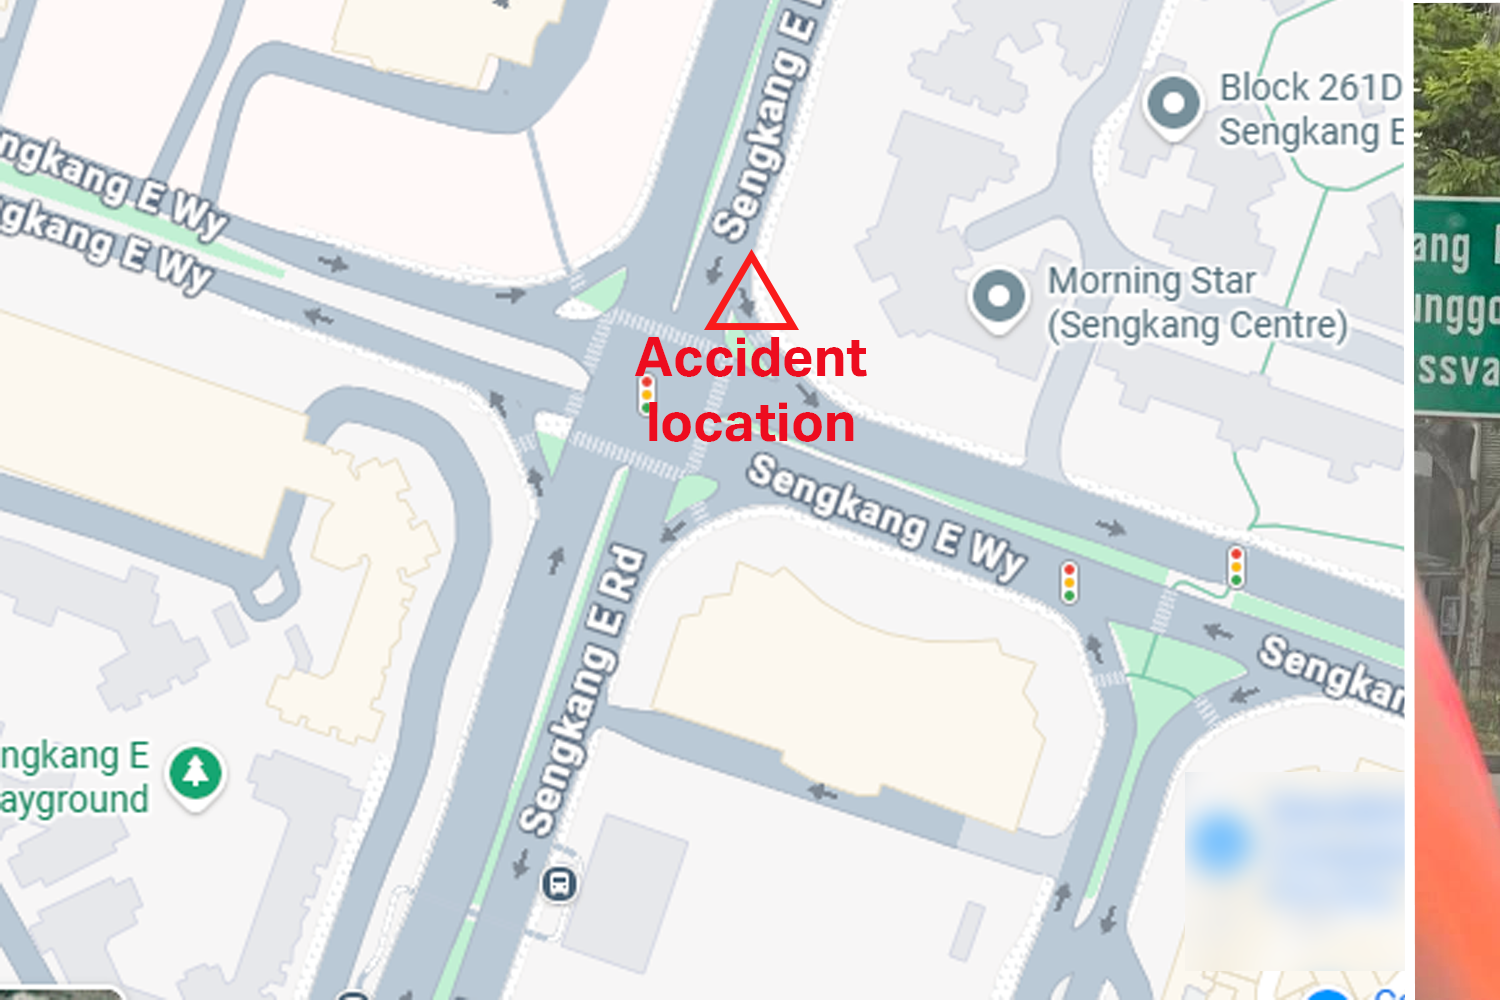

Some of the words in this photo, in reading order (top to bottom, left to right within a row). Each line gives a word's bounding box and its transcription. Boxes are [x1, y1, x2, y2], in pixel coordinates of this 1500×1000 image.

[1221, 70, 1310, 101] Block
[1319, 73, 1403, 101] 261D
[712, 48, 810, 244] Sengkang
[779, 9, 817, 44] E
[1220, 115, 1379, 153] Sengkang
[136, 178, 168, 215] E
[171, 188, 230, 244] Wy
[120, 233, 152, 272] E
[156, 246, 215, 298] Wy
[1049, 266, 1181, 302] Morning
[1191, 266, 1257, 294] Star
[1048, 308, 1219, 346] (Sengkang
[1230, 309, 1348, 346] Centre)
[747, 452, 929, 549] Sengkang
[933, 521, 965, 556] E
[970, 530, 1028, 585] Wy
[598, 543, 647, 602] Rd
[586, 603, 625, 637] E
[1, 739, 119, 777] ngkang
[131, 741, 149, 769] E
[519, 643, 619, 838] Sengkang
[0, 783, 148, 821] ayground
